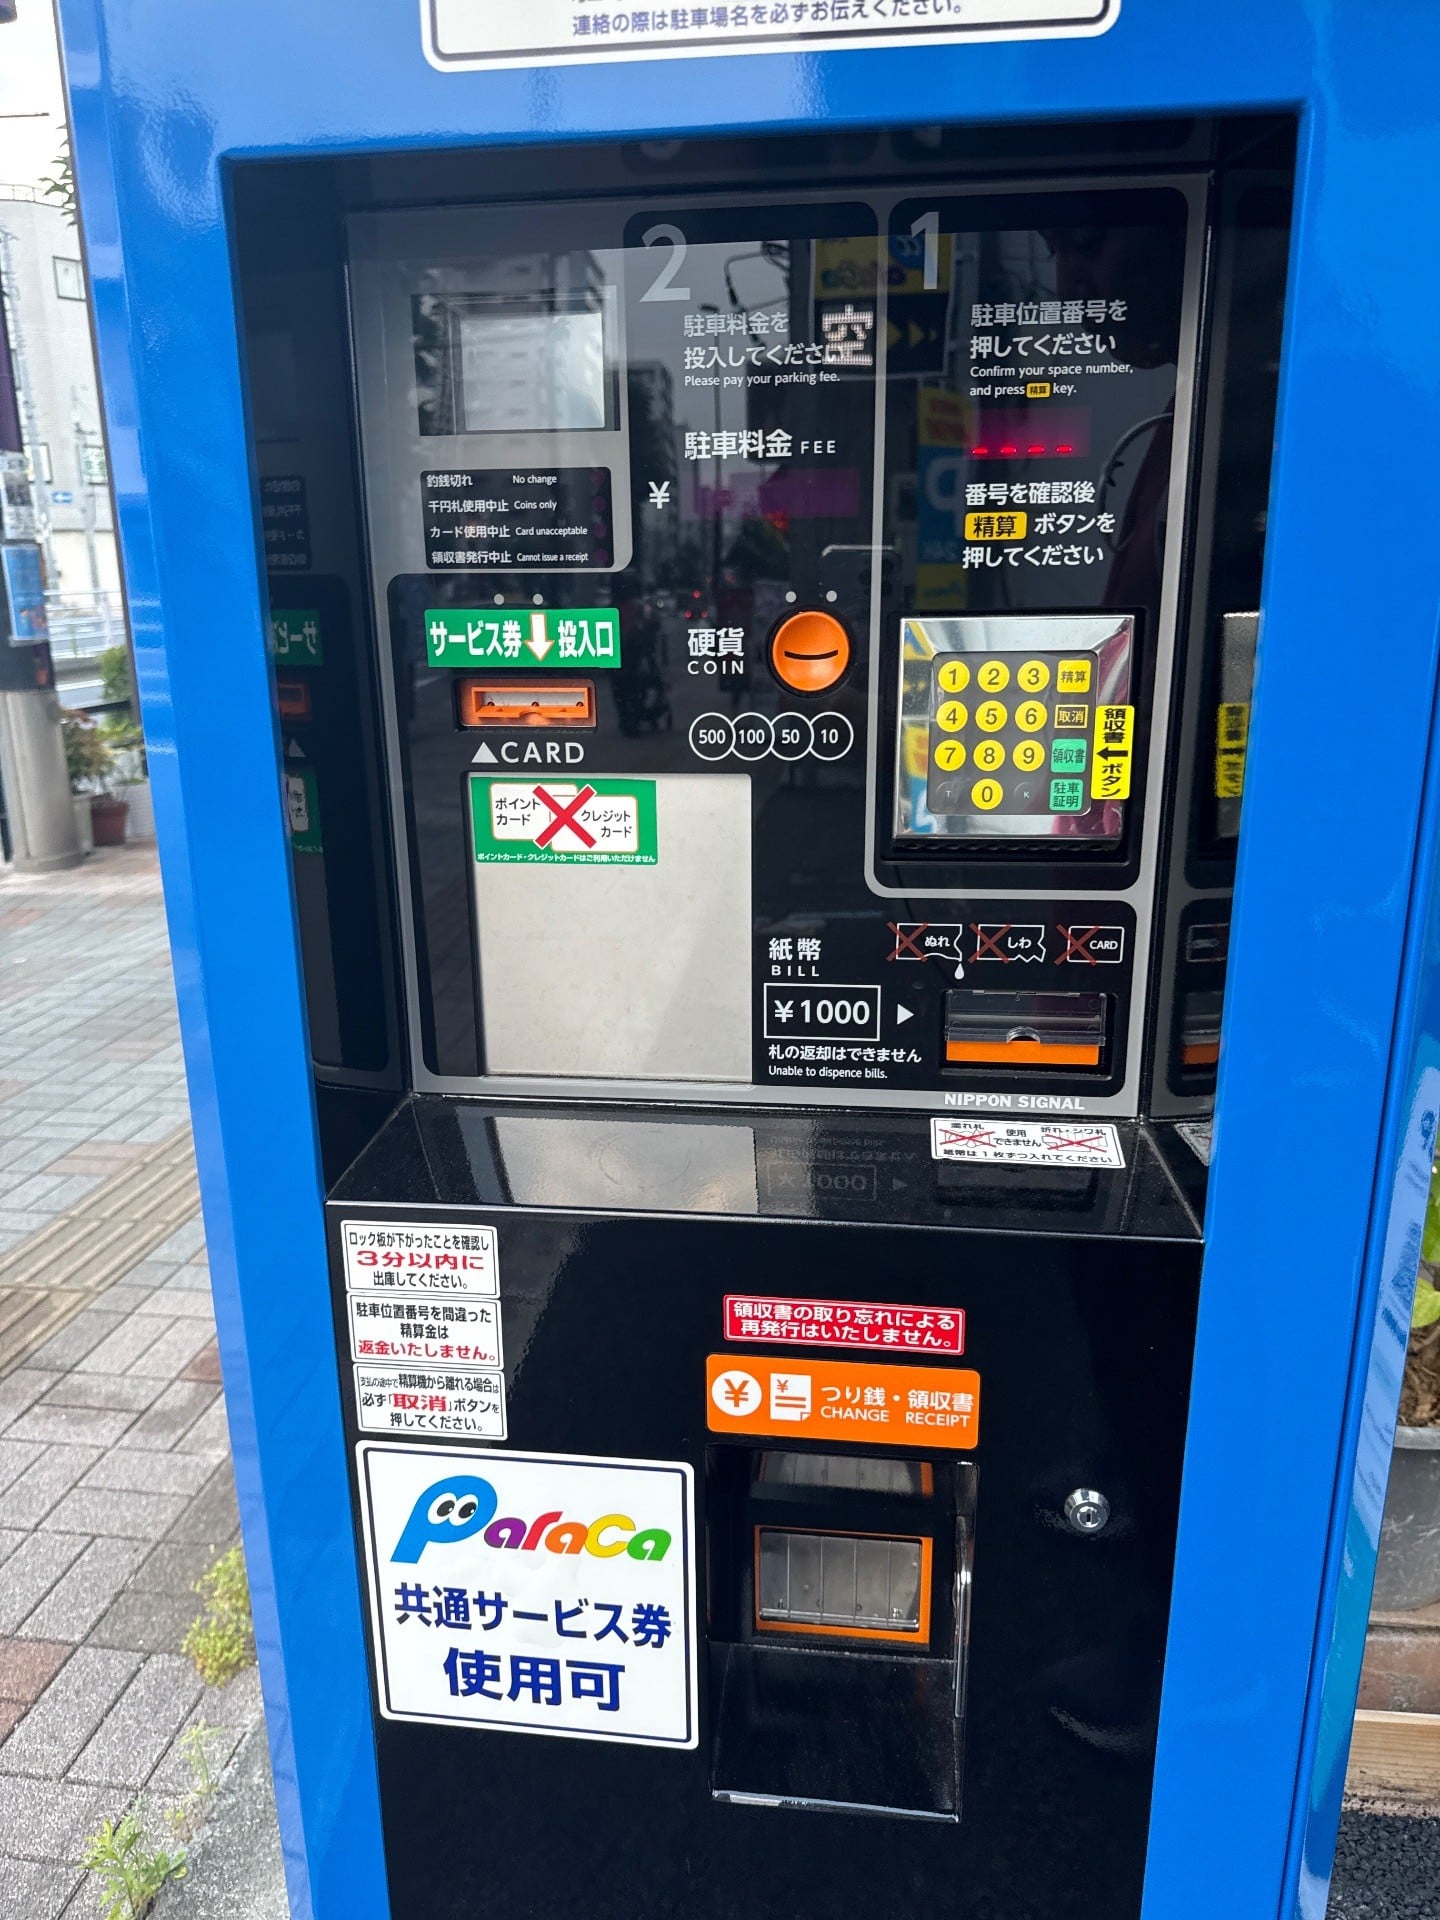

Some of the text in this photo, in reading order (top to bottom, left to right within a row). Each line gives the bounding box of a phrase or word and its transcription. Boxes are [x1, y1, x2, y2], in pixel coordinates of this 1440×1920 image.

[910, 211, 939, 290] 1
[640, 224, 691, 302] 2
[971, 300, 1128, 327] 駐車位置番号を
[684, 312, 788, 337] 駐車料金を
[970, 333, 1116, 359] 押してください
[684, 343, 844, 369] 投入してください
[684, 371, 841, 388] Please pay your parking fee.
[970, 362, 1134, 379] Confirm your space number,
[969, 384, 991, 396] and
[994, 384, 1025, 398] press
[1053, 382, 1077, 396] key.
[684, 428, 837, 460] 駐車料金 FEE
[426, 474, 558, 488] 釣銭切れ No change
[647, 481, 671, 509] ¥
[965, 480, 1096, 506] 番号を確認後
[428, 499, 558, 513] 千円札使用中止 Coins only
[430, 525, 589, 538] カード使用中止 Card unacceptable
[973, 511, 1116, 538] 精算 ボタンを
[431, 551, 589, 564] 領収書発行中止 Cannot issue a receipt
[962, 544, 1104, 569] 押してください
[430, 619, 615, 659] サービス券 投入口
[687, 627, 745, 657] 硬貨
[687, 660, 745, 675] COIN
[948, 668, 957, 686] 1
[987, 668, 1000, 686] 2
[1027, 668, 1040, 686] 3
[1060, 670, 1087, 684] 精算
[945, 708, 958, 725] 4
[985, 708, 998, 725] 5
[1025, 708, 1037, 725] 6
[1058, 710, 1086, 723] 取消
[1103, 708, 1126, 744] 領収書
[698, 728, 839, 744] 500 100 50 10
[500, 741, 585, 764] CARD
[944, 747, 957, 764] 7
[983, 747, 996, 764] 8
[1023, 747, 1035, 764] 9
[1052, 748, 1086, 764] 領収書
[1053, 782, 1080, 796] 駐車
[1101, 763, 1123, 798] ボタン
[981, 786, 993, 803] 0
[1053, 795, 1079, 808] 証明
[495, 798, 541, 811] ポイント
[496, 813, 531, 826] カード
[581, 810, 631, 823] クレジット
[601, 826, 632, 838] カード
[768, 937, 822, 962] 紙幣
[924, 935, 951, 948] ぬれ
[1007, 936, 1032, 949] しわ
[1089, 940, 1118, 951] CARD
[771, 964, 820, 977] BILL
[768, 1044, 922, 1063] 札の返却はできません
[768, 1066, 888, 1081] Unable to dispence bills.
[944, 1092, 1085, 1111] NIPPON SIGNAL
[1005, 1128, 1027, 1138] 使用
[349, 1232, 489, 1251] ロック板が下がったことを確認し
[356, 1250, 485, 1270] 3分以内に
[373, 1271, 468, 1290] 出庫してください。
[356, 1302, 492, 1324] 駐車位置番号を間違った
[733, 1301, 956, 1330] 領収書の取り忘れによる
[400, 1323, 449, 1339] 精算金は
[741, 1320, 952, 1348] 再発行はいたしません。
[358, 1340, 496, 1361] 返金いたしません。
[362, 1392, 500, 1414] 必ず「取消」ボタンを
[820, 1385, 974, 1413] つり銭・領収書
[390, 1412, 483, 1432] 押してください。
[820, 1405, 971, 1428] CHANGE RECEIPT
[395, 1582, 672, 1649] 共通サービス券
[443, 1647, 626, 1712] 使用可
